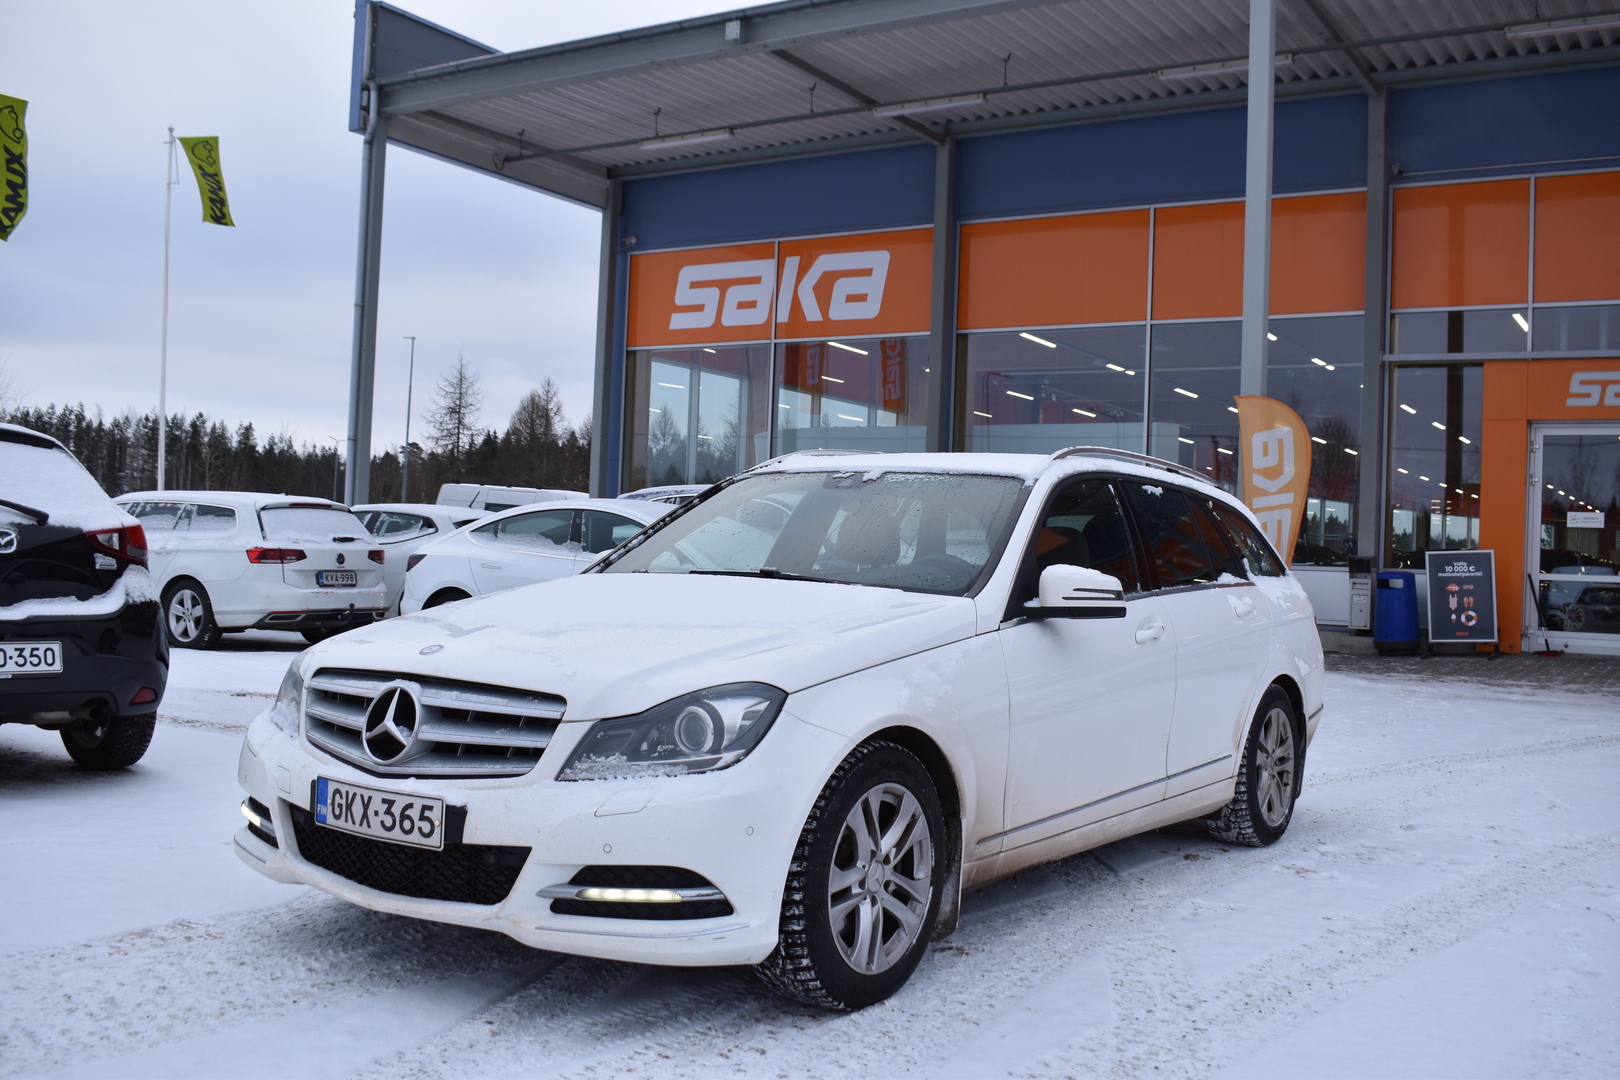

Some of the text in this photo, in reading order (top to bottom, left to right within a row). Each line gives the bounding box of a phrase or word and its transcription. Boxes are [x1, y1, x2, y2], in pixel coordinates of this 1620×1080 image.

[198, 163, 228, 226] KAMUX
[324, 573, 355, 583] KVA-998
[317, 804, 327, 816] FIN
[331, 788, 436, 839] GKX-365
